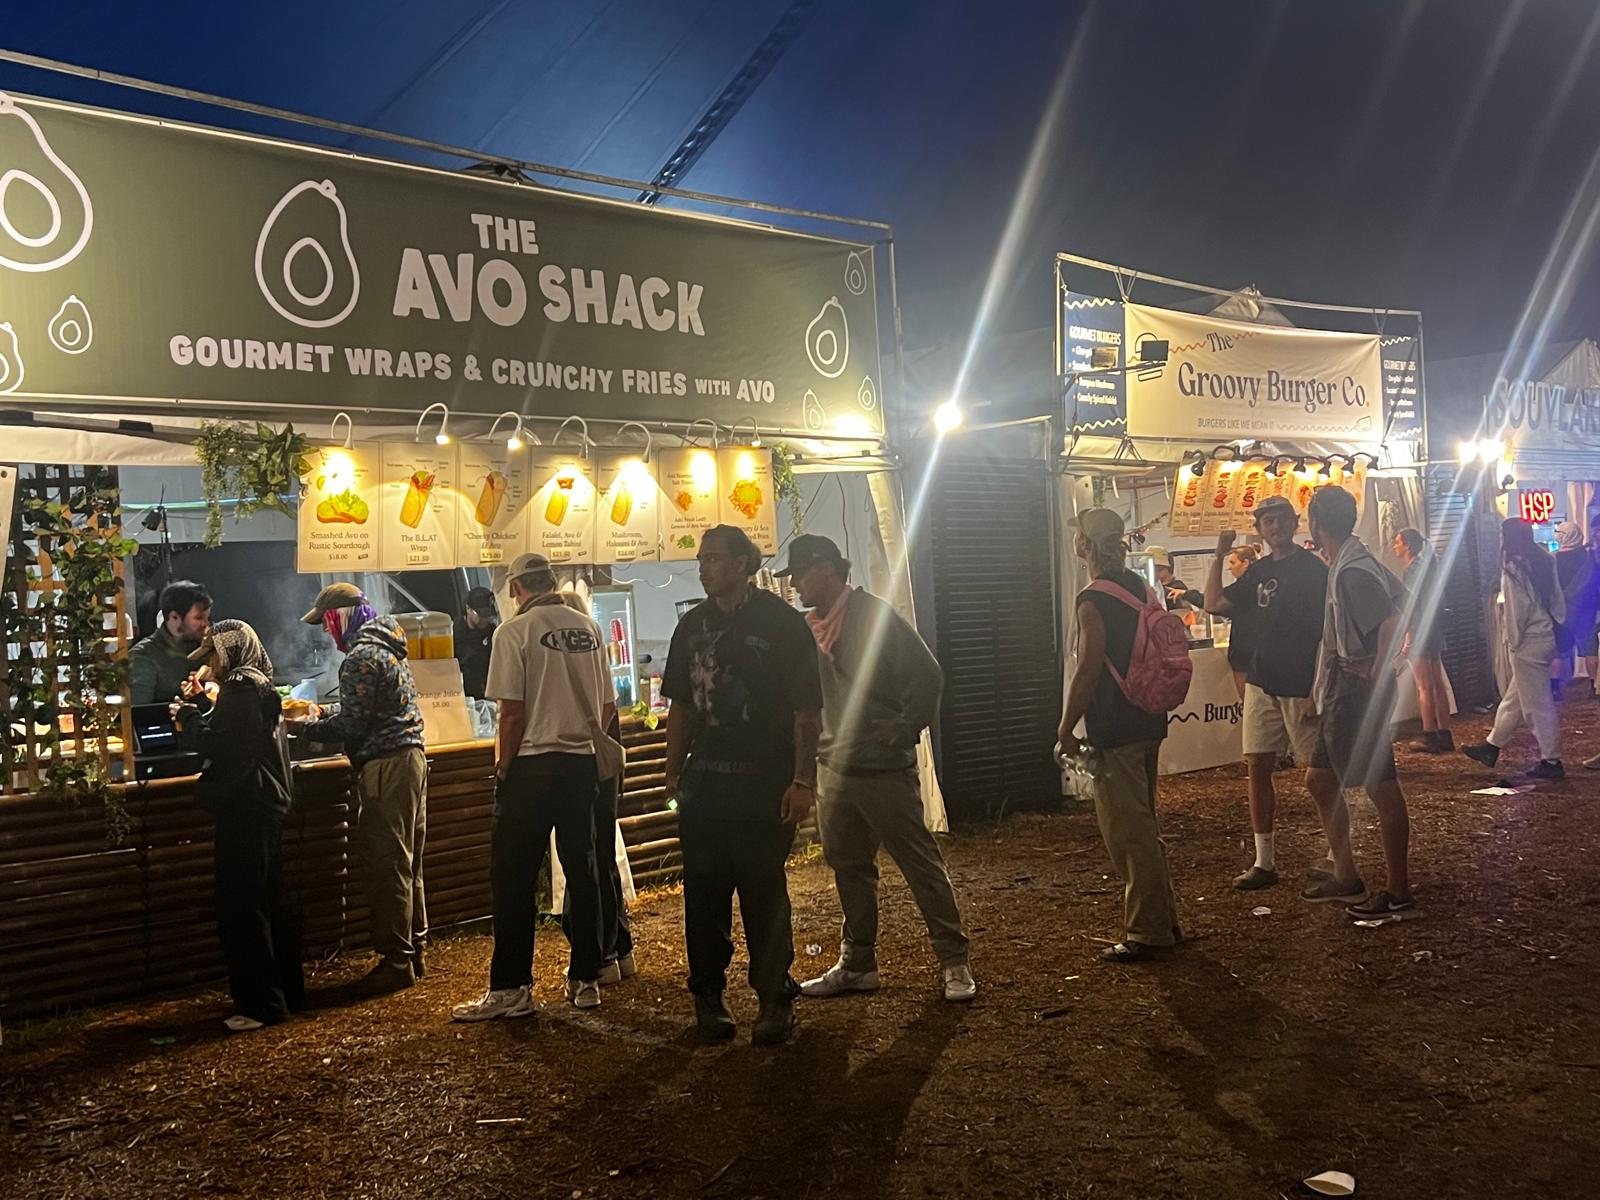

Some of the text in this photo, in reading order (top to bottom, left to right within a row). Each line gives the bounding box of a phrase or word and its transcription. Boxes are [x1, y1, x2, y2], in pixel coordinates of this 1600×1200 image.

[471, 213, 539, 254] THE
[393, 247, 705, 336] AVO SHACK
[1069, 325, 1121, 345] GOURMET BURGERS
[1206, 331, 1234, 353] The
[169, 335, 775, 403] GOURMET WRAPS & CRUNCHY FRIES WITH AVO
[1178, 361, 1370, 413] Groovy Burger Co.
[1198, 417, 1226, 429] BURGERS
[1227, 419, 1240, 429] LIKE
[1241, 420, 1250, 429] WE
[1520, 491, 1555, 521] HSP
[309, 541, 370, 550] Rustic Sourdough
[310, 531, 343, 539] Smashed
[401, 534, 413, 542] The
[410, 544, 428, 552] Wrap
[417, 691, 441, 699] Orange
[1204, 702, 1244, 724] Burge
